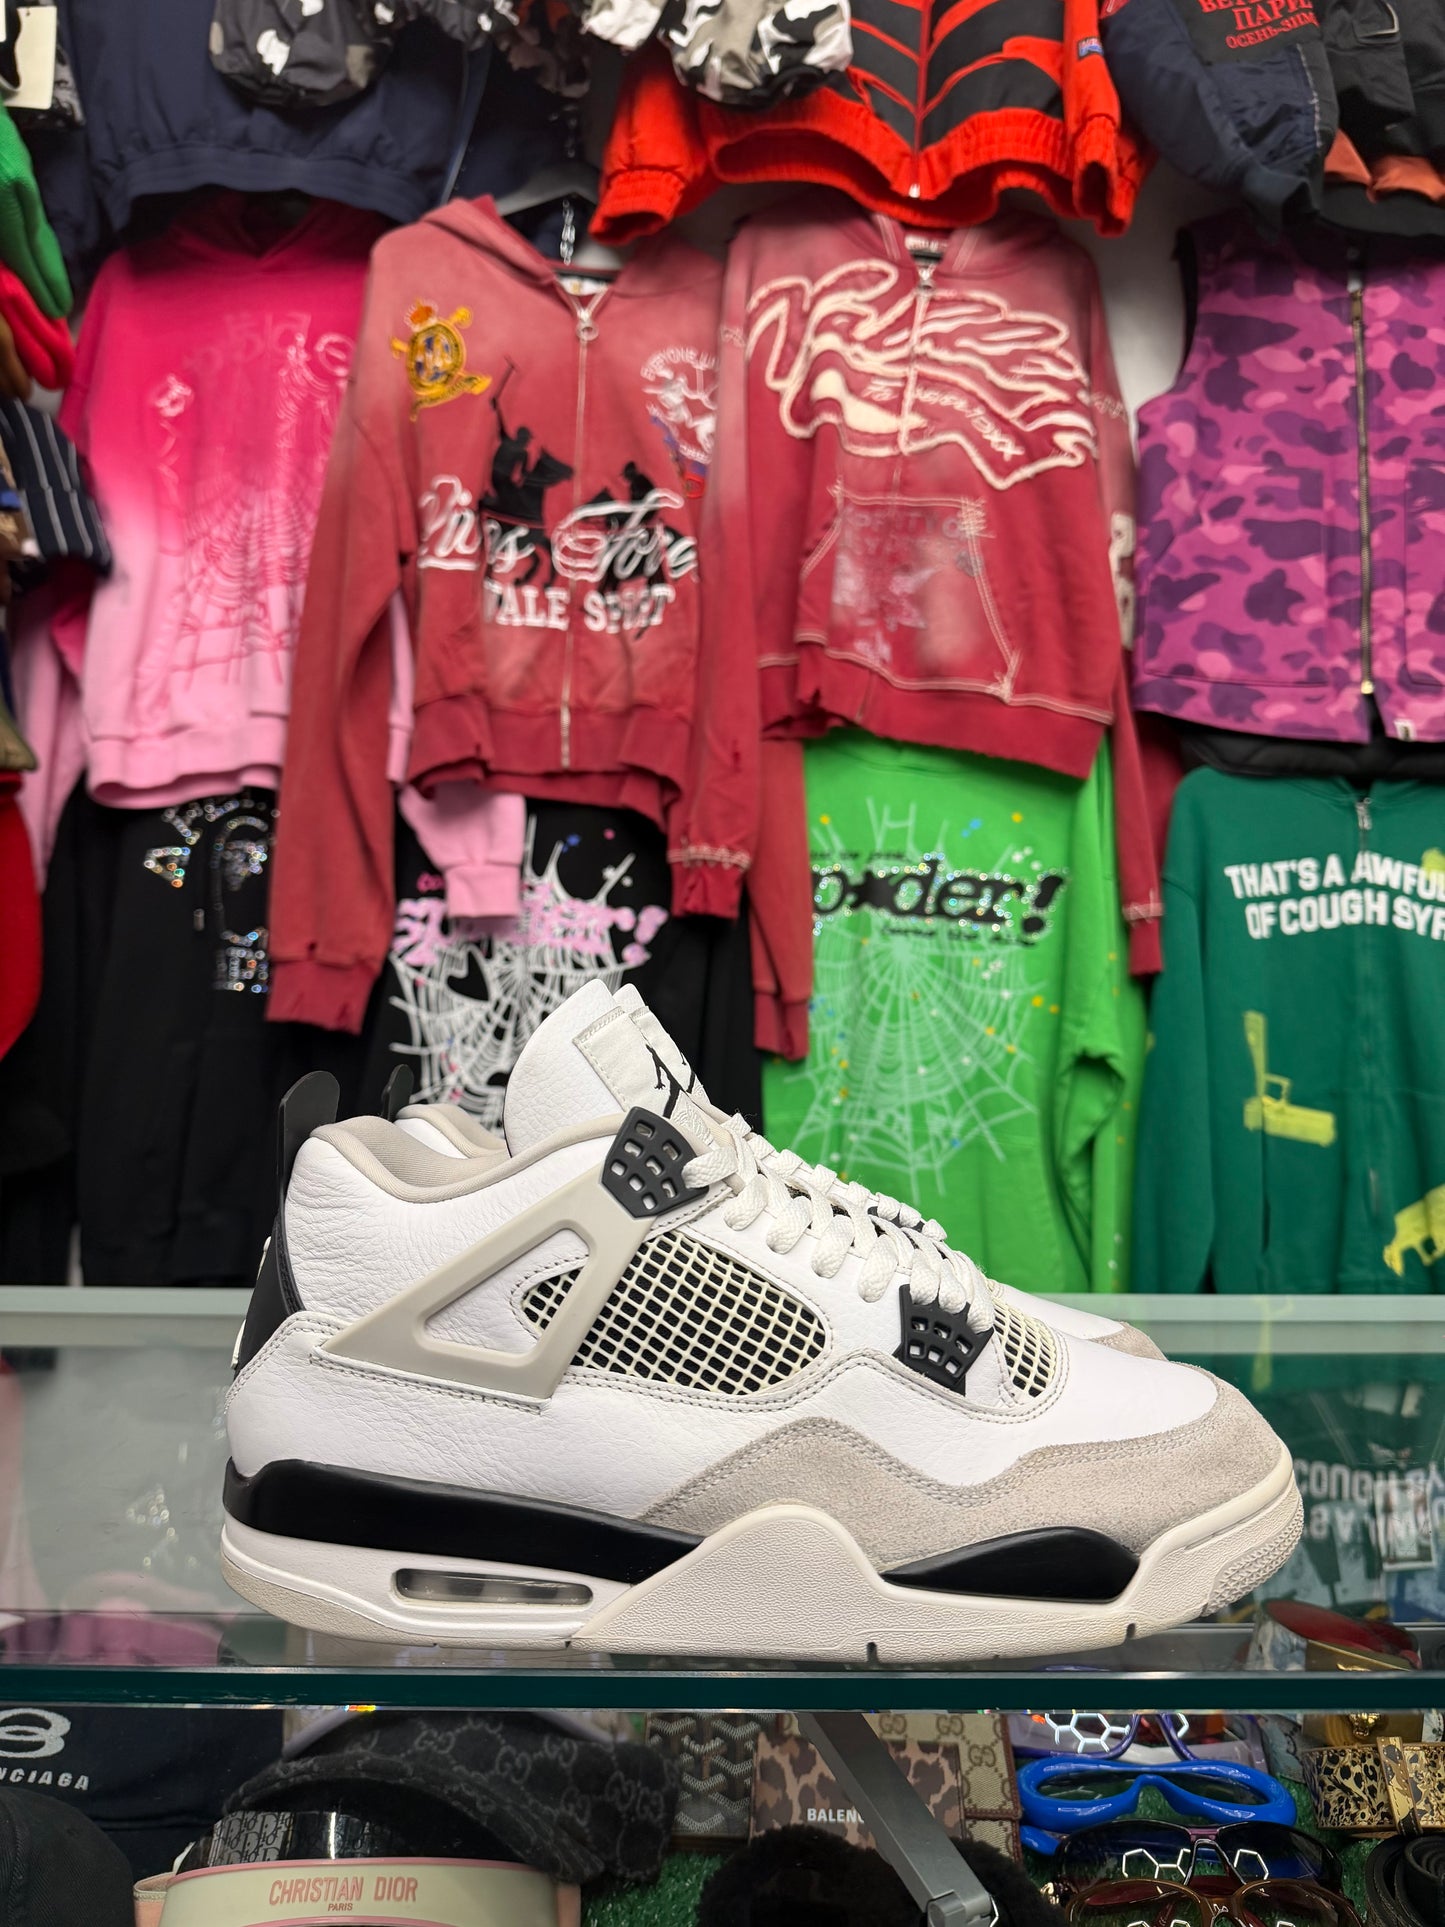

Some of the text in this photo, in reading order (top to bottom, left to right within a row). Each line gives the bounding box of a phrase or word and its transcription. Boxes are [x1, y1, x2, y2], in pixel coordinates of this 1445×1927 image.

[1224, 857, 1320, 899] THAT'S
[1323, 853, 1347, 888] A
[1245, 902, 1277, 940] OF
[1279, 889, 1389, 936] COUGH
[269, 1876, 418, 1905] CHRISTIAN DIOR
[327, 1903, 353, 1911] PARIS
